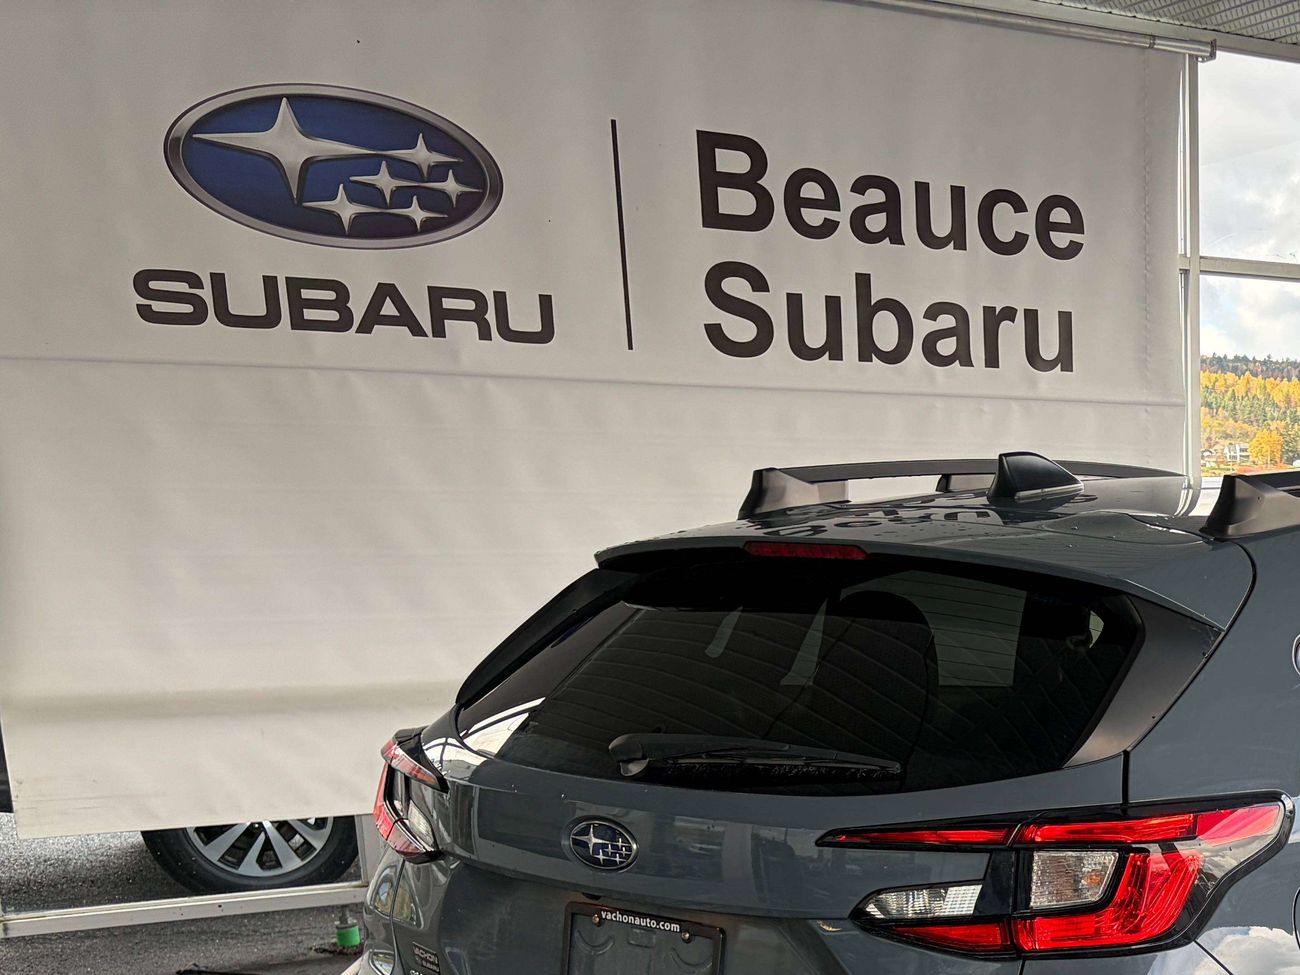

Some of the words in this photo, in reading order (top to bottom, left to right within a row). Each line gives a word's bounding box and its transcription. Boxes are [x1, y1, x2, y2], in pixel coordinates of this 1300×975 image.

[695, 129, 1085, 261] Beauce
[132, 268, 555, 345] SUBARU
[703, 260, 1074, 373] Subaru
[601, 910, 680, 933] vachonauto.com
